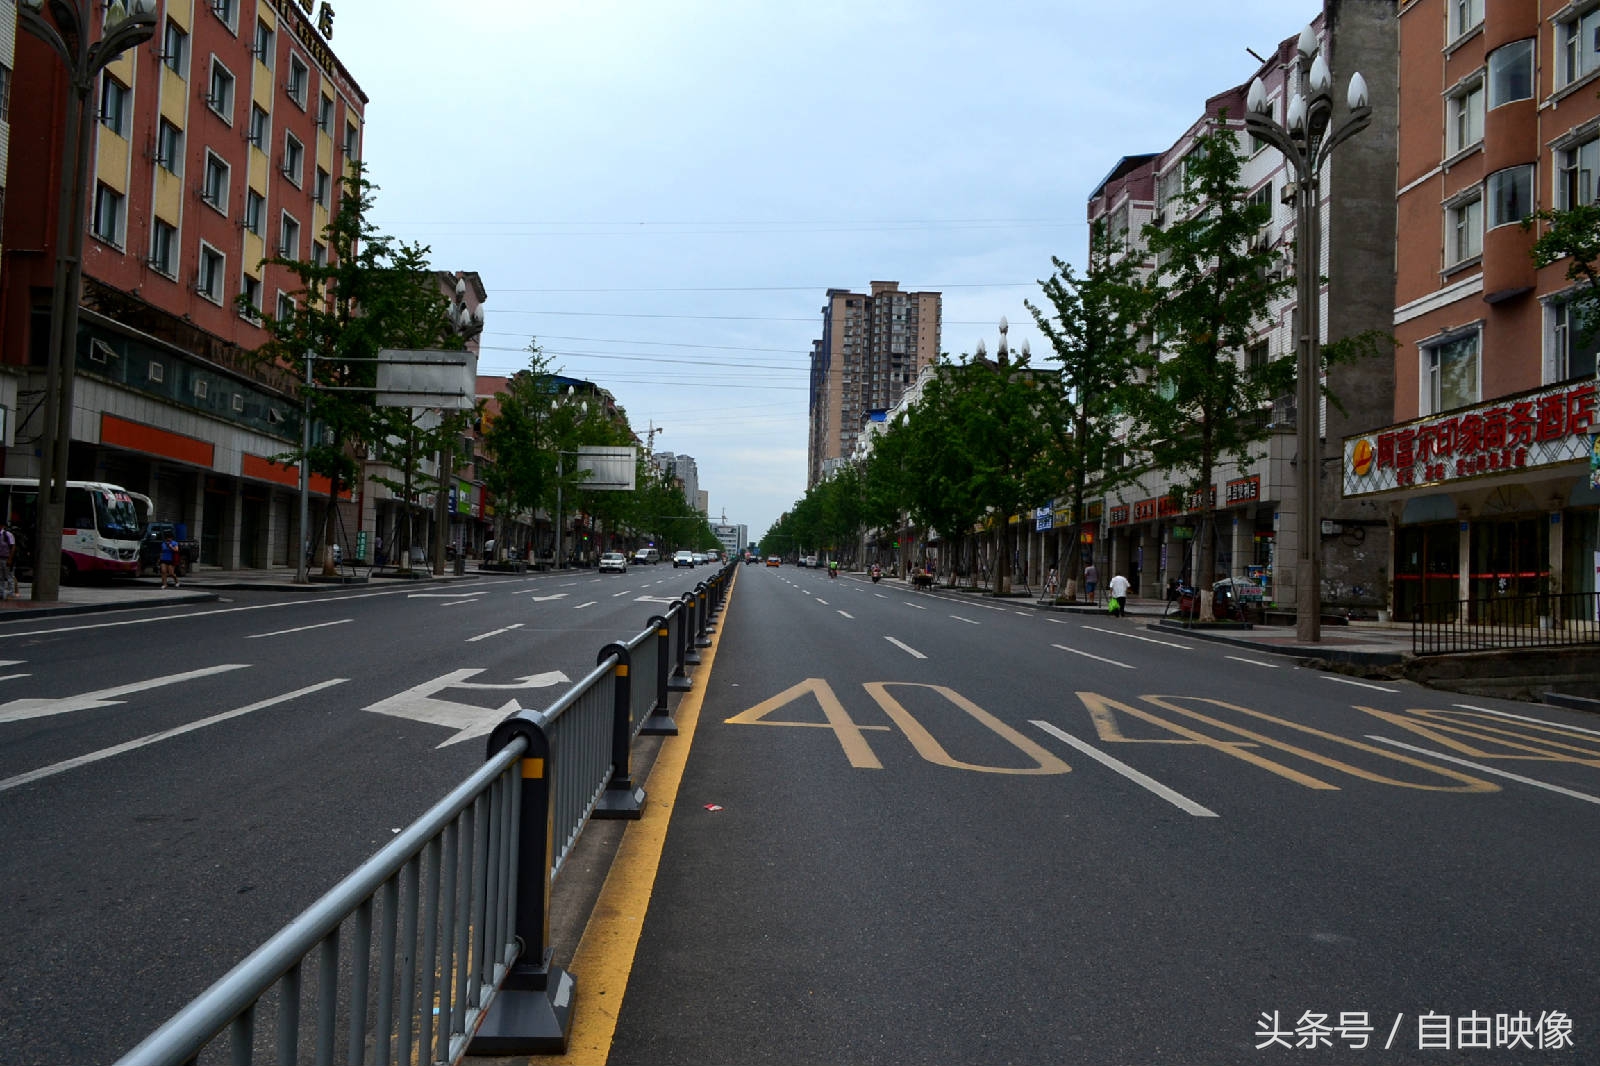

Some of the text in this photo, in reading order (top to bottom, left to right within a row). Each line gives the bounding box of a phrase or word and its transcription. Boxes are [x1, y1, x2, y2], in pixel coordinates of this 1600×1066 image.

[1377, 385, 1596, 471] 阿富尔印象商务酒店
[724, 678, 1072, 775] 40
[1075, 692, 1500, 793] 40
